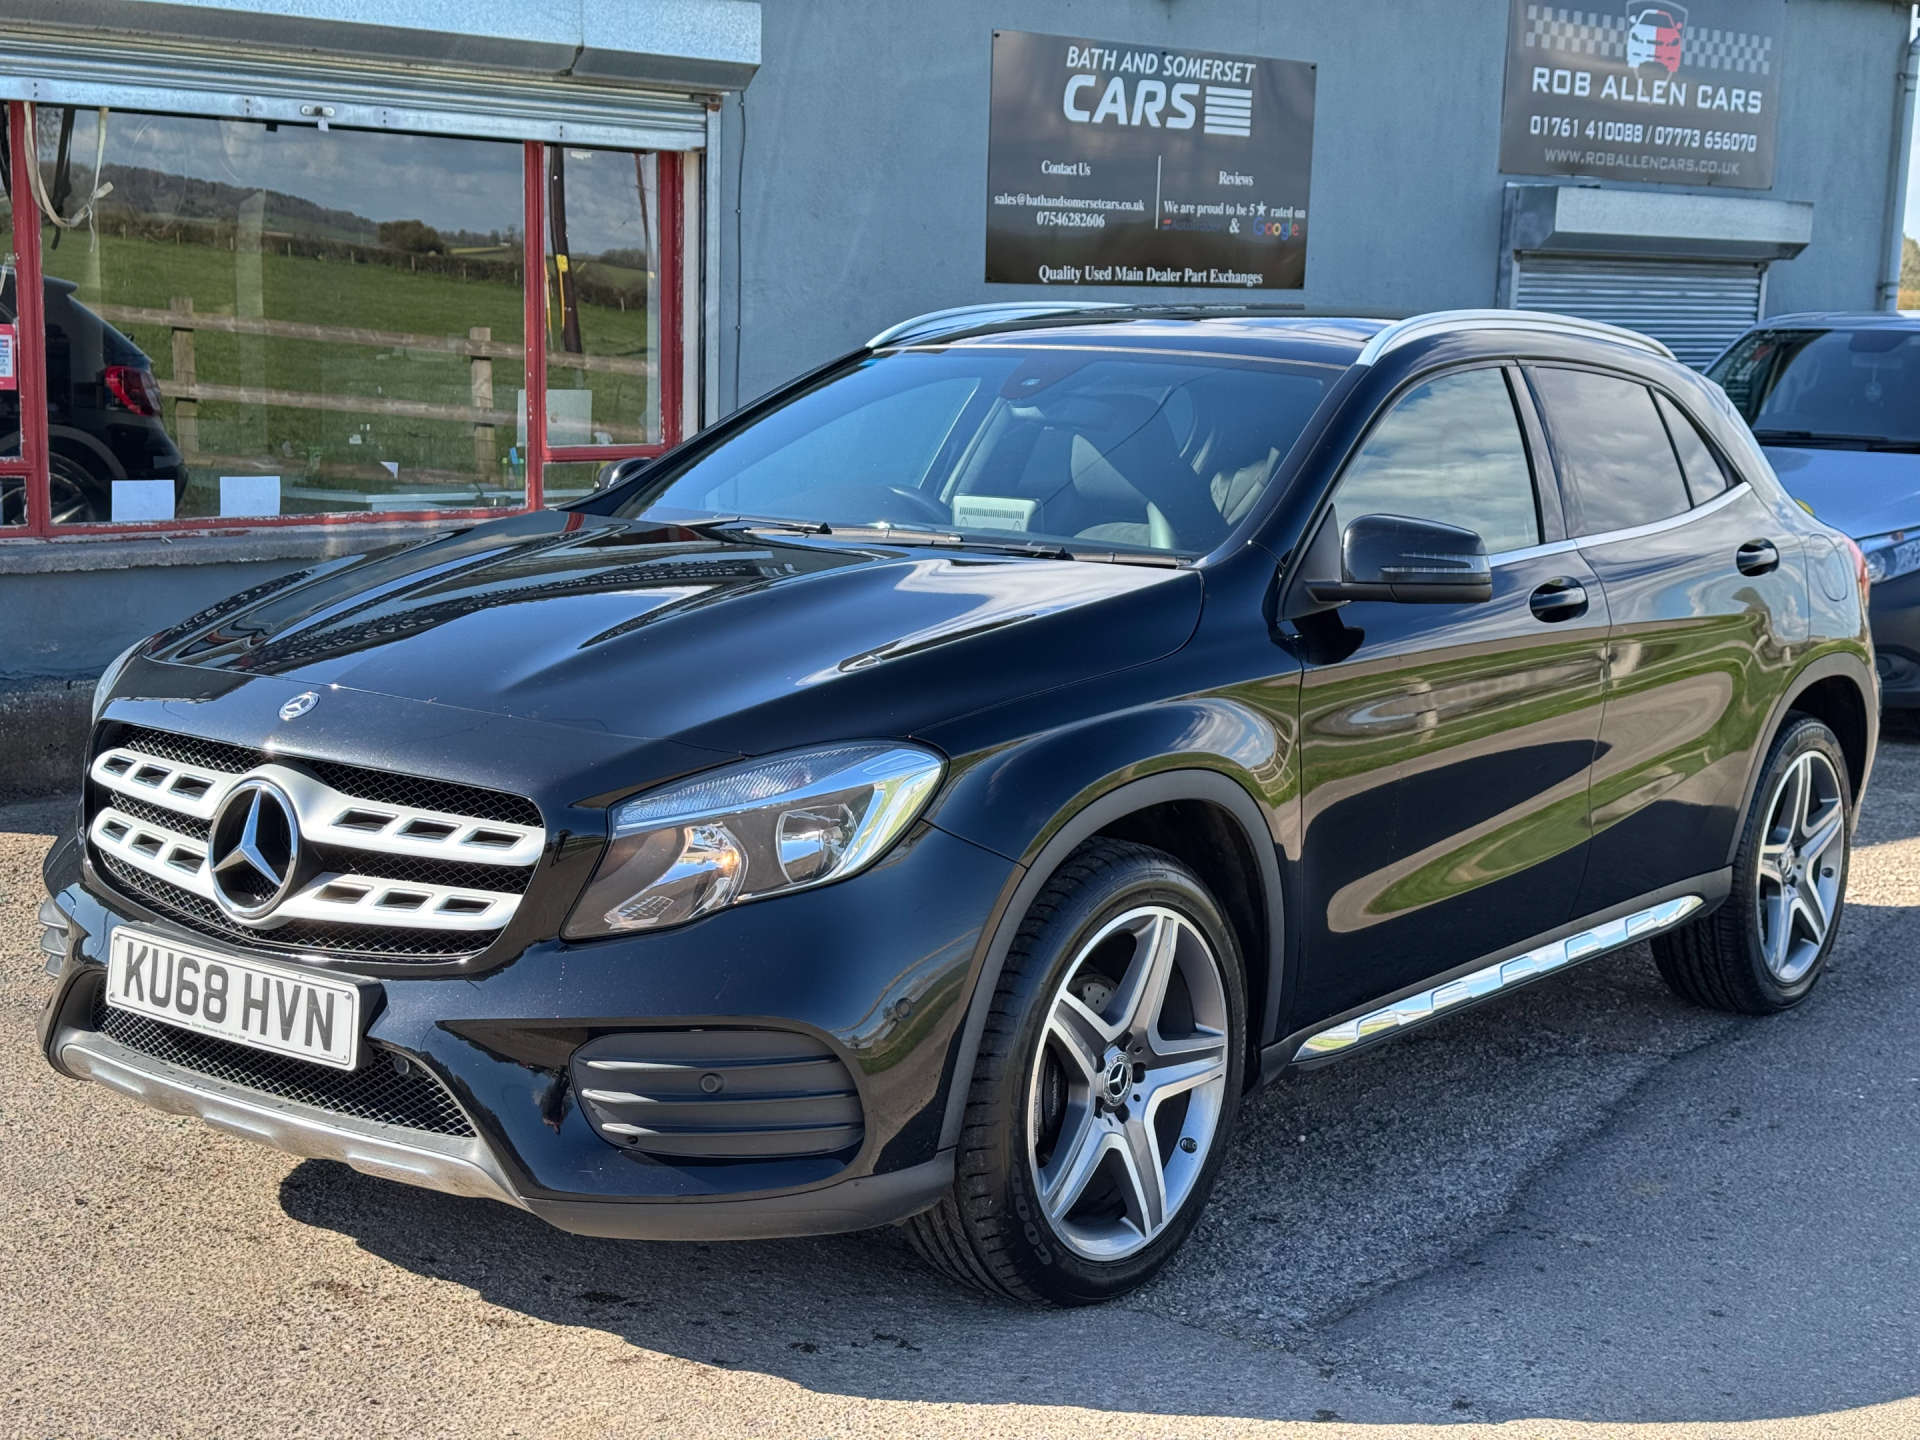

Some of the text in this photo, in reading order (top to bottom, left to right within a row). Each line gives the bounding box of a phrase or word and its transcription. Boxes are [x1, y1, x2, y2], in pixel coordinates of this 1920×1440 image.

[1066, 46, 1257, 84] BATH AND SOMERSET
[1063, 73, 1201, 130] CARS
[1531, 66, 1763, 114] ROB ALLEN CARS
[1529, 115, 1579, 138] 01761
[1654, 126, 1700, 148] 07773
[1704, 130, 1758, 153] 656070
[1041, 159, 1092, 177] Contact Us
[1544, 148, 1740, 176] WWW.ROBALLENCARS.CO.UK
[1218, 170, 1254, 186] Reviews
[993, 193, 1145, 211] sales@bathandsomersetcars.co.uk
[1163, 200, 1179, 214] We
[1180, 204, 1196, 214] are
[1196, 202, 1224, 217] proud
[1225, 204, 1235, 215] to
[1236, 204, 1248, 216] be
[1270, 206, 1294, 218] rated
[1294, 208, 1306, 218] on
[1036, 211, 1106, 228] 07546282606
[1229, 217, 1241, 234] &
[1253, 217, 1300, 241] Google
[1038, 264, 1264, 287] Quality Used Main Dealer Part Exchanges
[123, 941, 335, 1052] KU68 HVN
